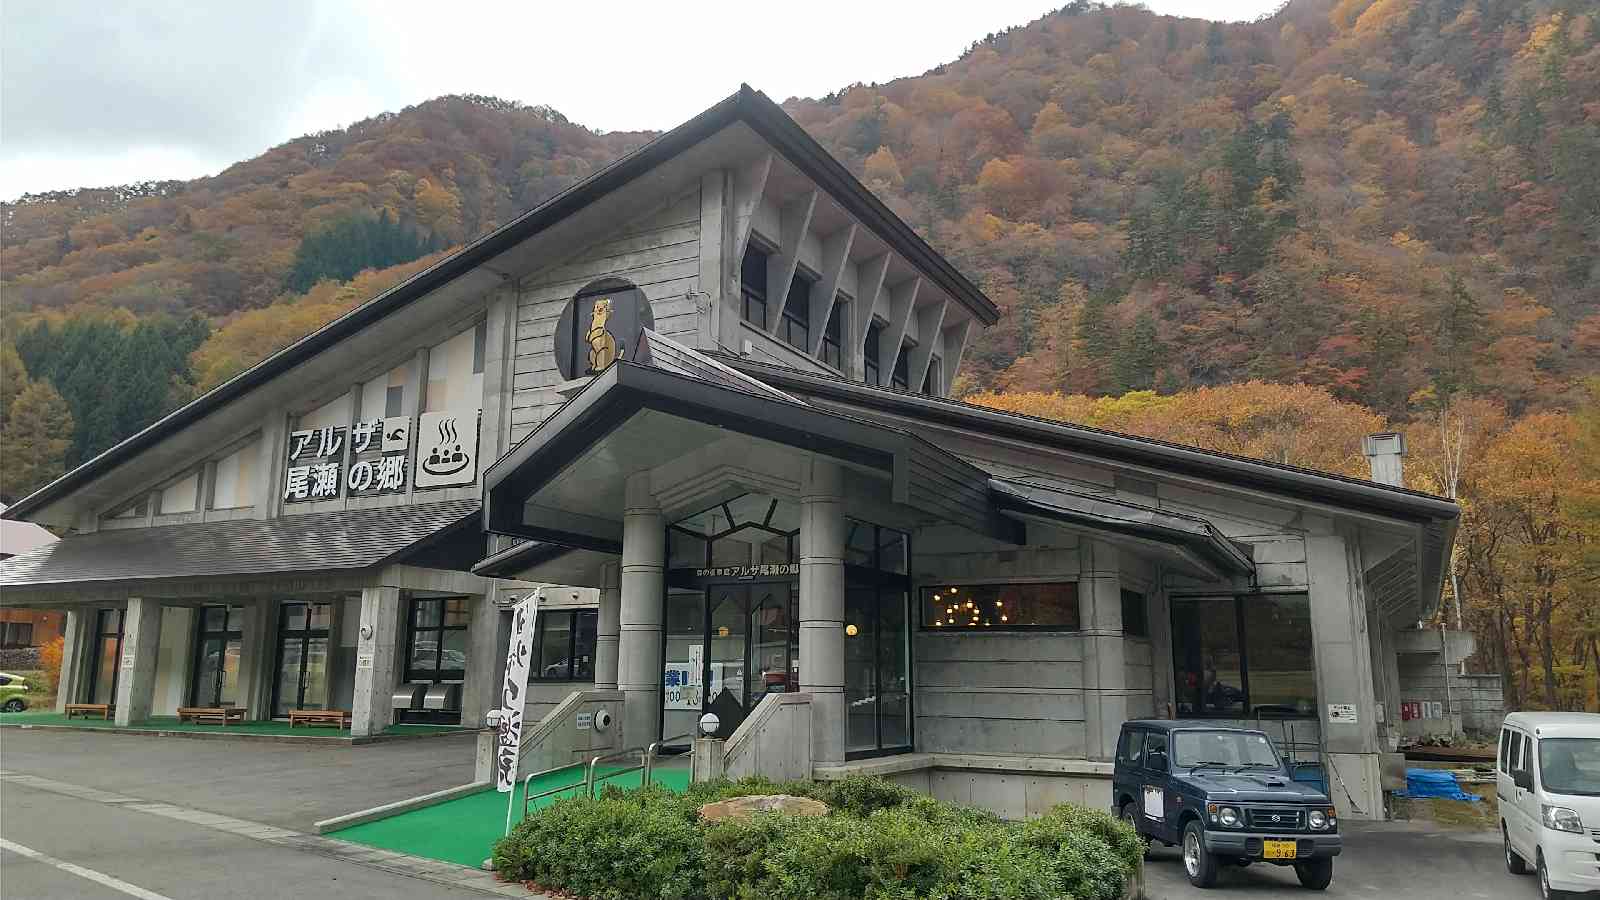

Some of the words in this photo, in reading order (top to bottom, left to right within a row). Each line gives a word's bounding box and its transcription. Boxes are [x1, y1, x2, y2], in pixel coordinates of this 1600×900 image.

[291, 417, 384, 460] アルザ
[284, 455, 405, 499] 尾瀬の郷
